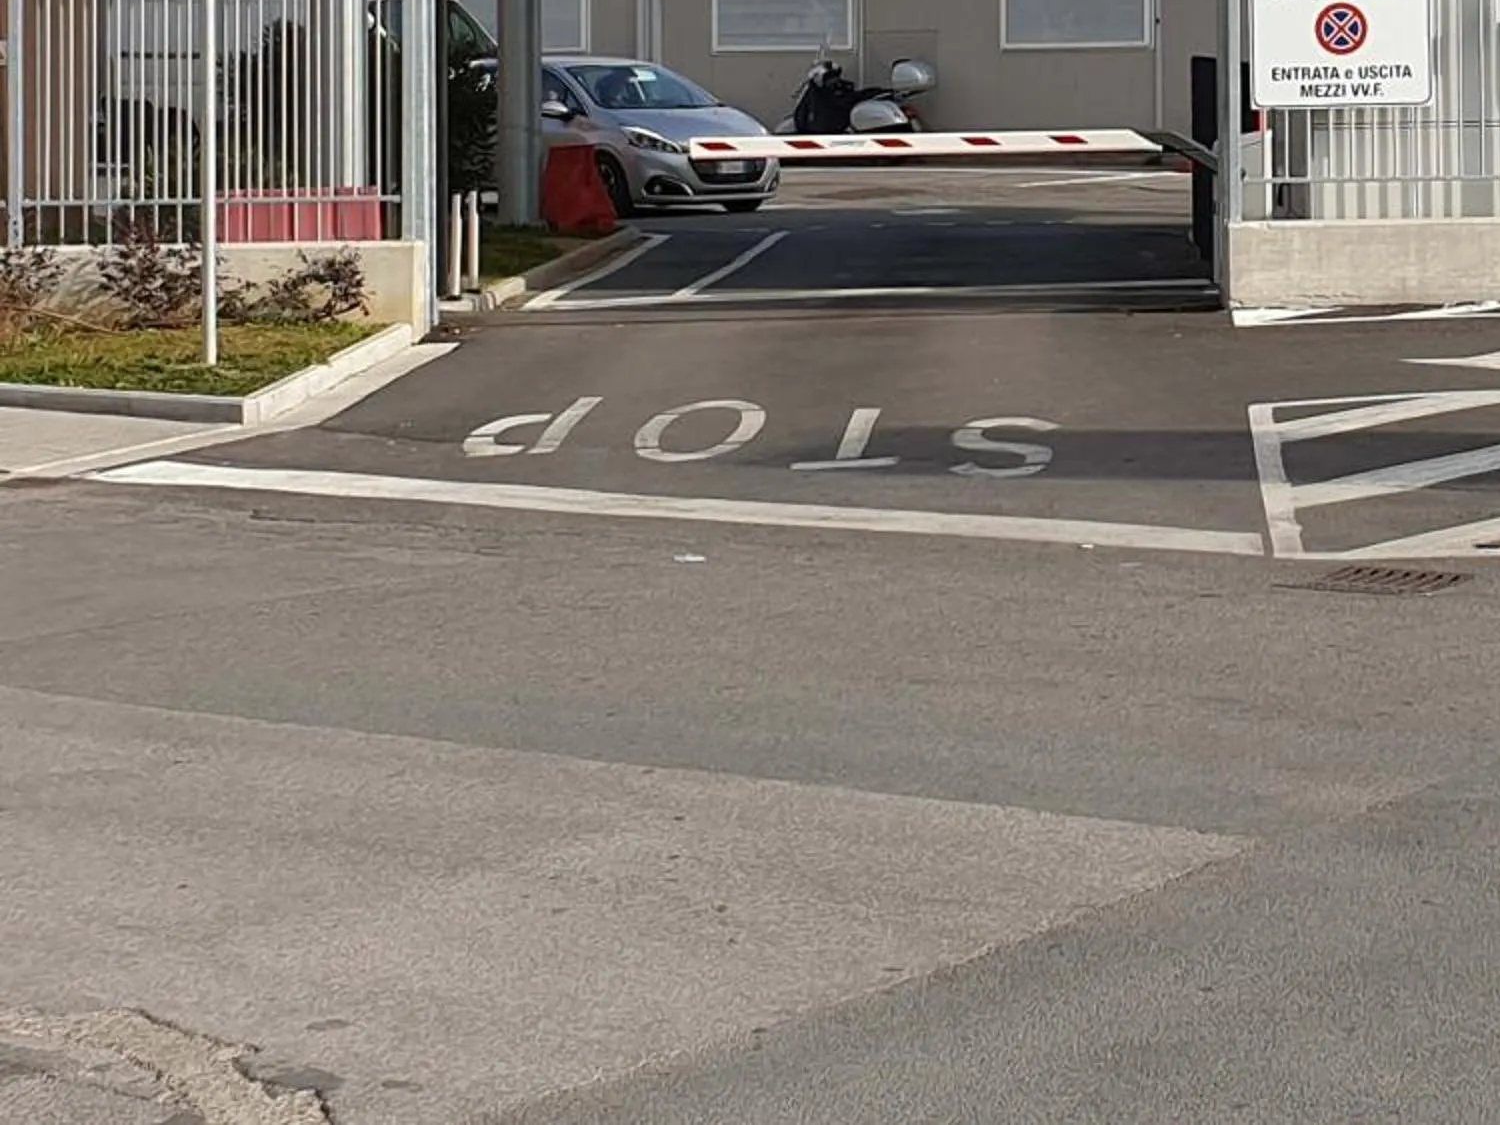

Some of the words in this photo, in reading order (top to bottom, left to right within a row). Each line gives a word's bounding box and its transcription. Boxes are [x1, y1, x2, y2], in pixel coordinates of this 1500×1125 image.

[1271, 66, 1340, 81] ENTRATA
[1344, 69, 1353, 79] e
[1357, 64, 1412, 79] USCITA
[1300, 84, 1346, 97] MEZZI
[1350, 82, 1385, 97] VV.F.
[463, 396, 1062, 477] STOP
